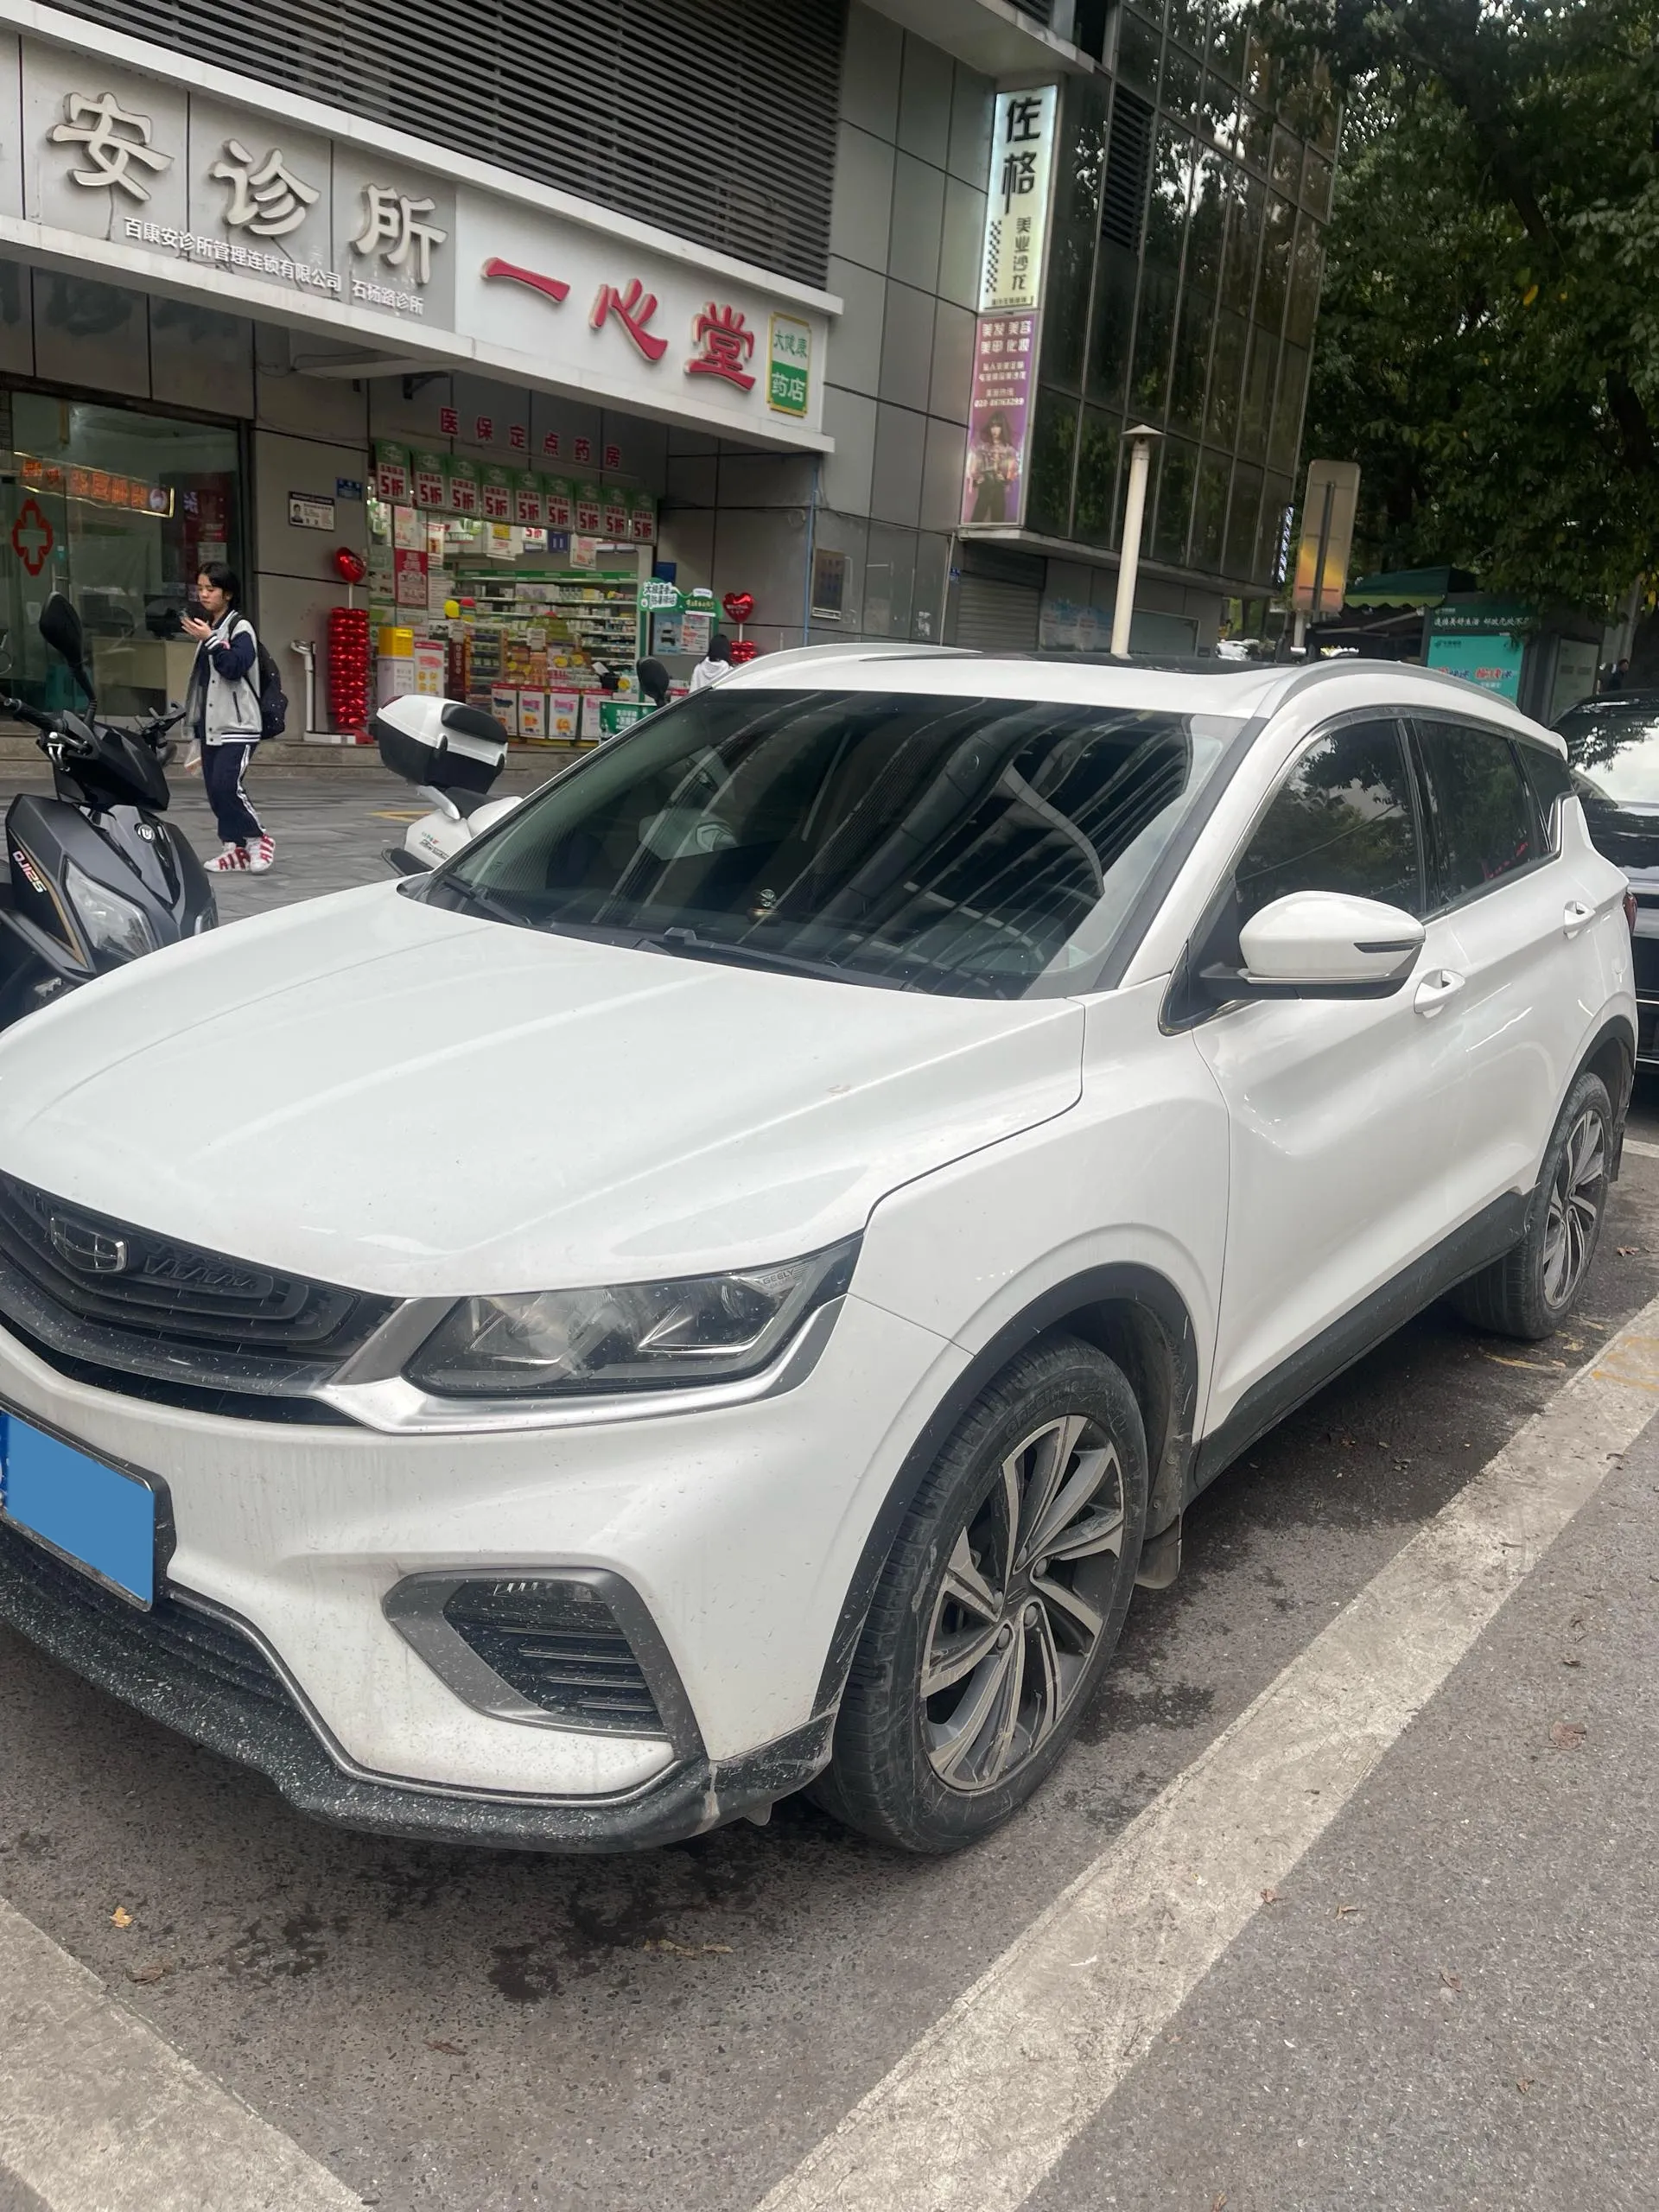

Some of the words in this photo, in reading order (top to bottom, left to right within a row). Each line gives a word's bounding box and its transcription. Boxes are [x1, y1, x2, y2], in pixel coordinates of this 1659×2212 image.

[46, 92, 448, 284] 安诊所
[1001, 97, 1043, 215] 佐格
[124, 217, 342, 292] 百康安诊所管理连锁有限公司
[1012, 216, 1032, 291] 美业沙龙
[480, 257, 756, 392] 一心堂
[772, 372, 806, 402] 药店
[440, 407, 623, 469] 医保定点药房
